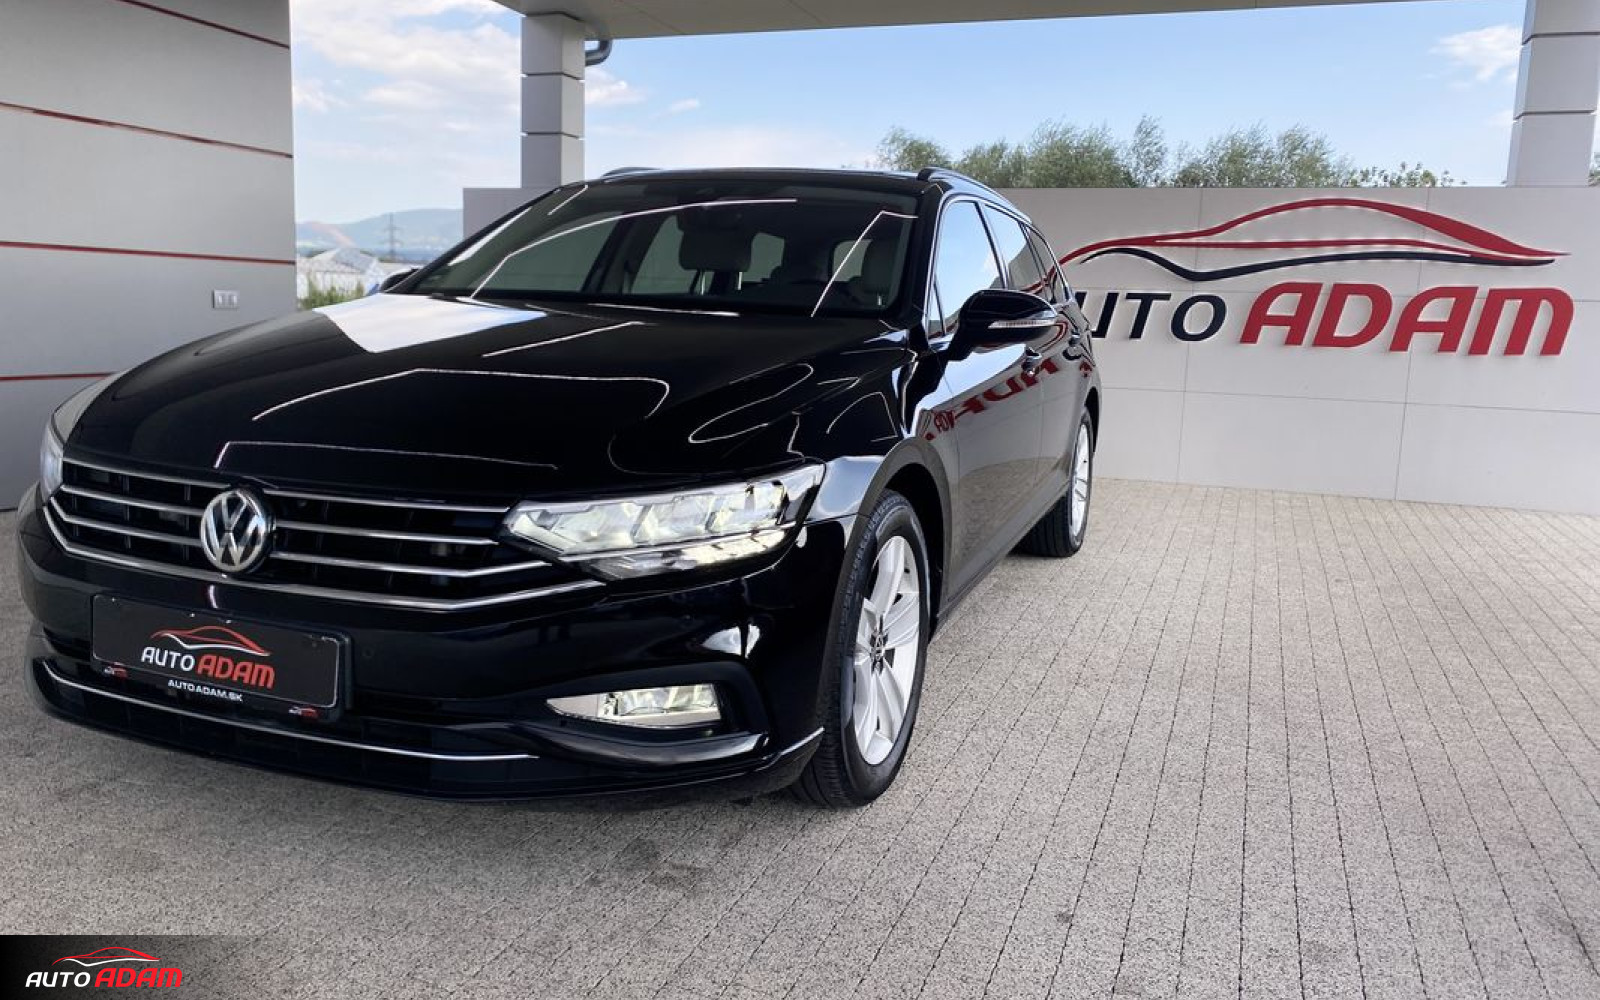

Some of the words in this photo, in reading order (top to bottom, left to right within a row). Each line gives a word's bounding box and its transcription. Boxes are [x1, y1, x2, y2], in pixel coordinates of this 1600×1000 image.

[1075, 291, 1227, 342] UTO
[1239, 281, 1575, 357] ADAM
[141, 646, 196, 672] AUTO
[197, 654, 276, 690] ADAM
